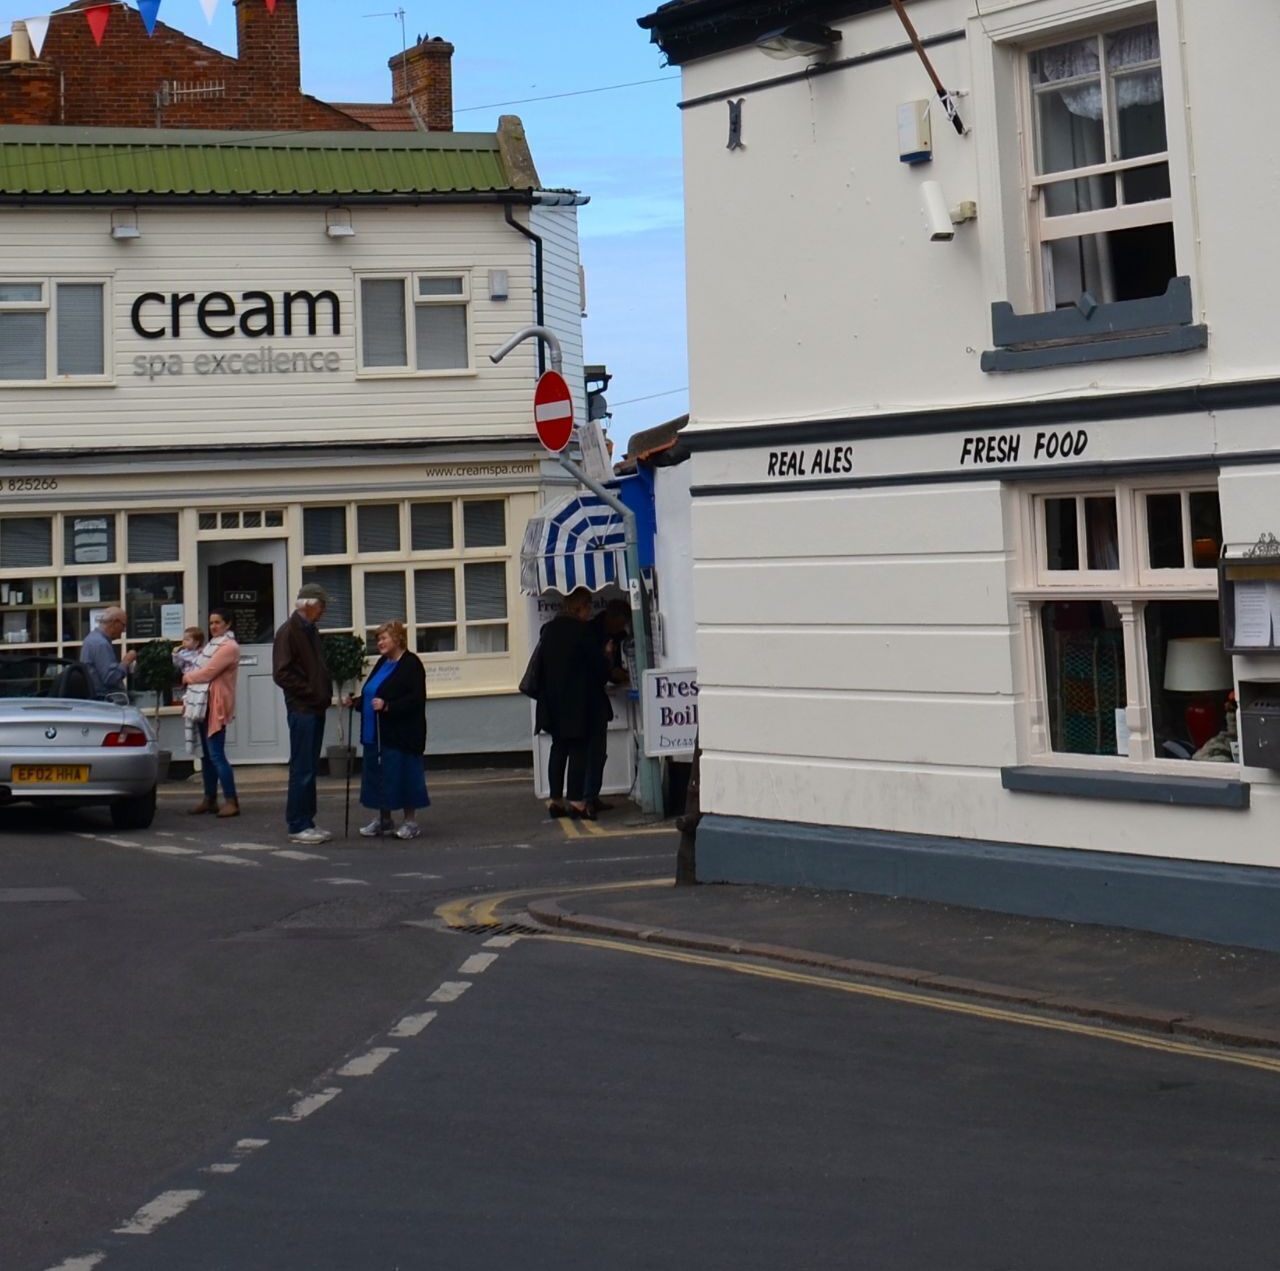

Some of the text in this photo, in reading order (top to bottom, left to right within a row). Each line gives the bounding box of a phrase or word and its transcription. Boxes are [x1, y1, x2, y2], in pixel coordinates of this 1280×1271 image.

[131, 290, 340, 339] cream
[133, 346, 340, 381] spa excellence
[768, 447, 853, 476] REAL ALES
[961, 430, 1088, 465] FRESH FOOD
[8, 477, 58, 491] 825266
[425, 463, 534, 477] www.creamspa.com
[19, 768, 82, 781] EF02 HHA
